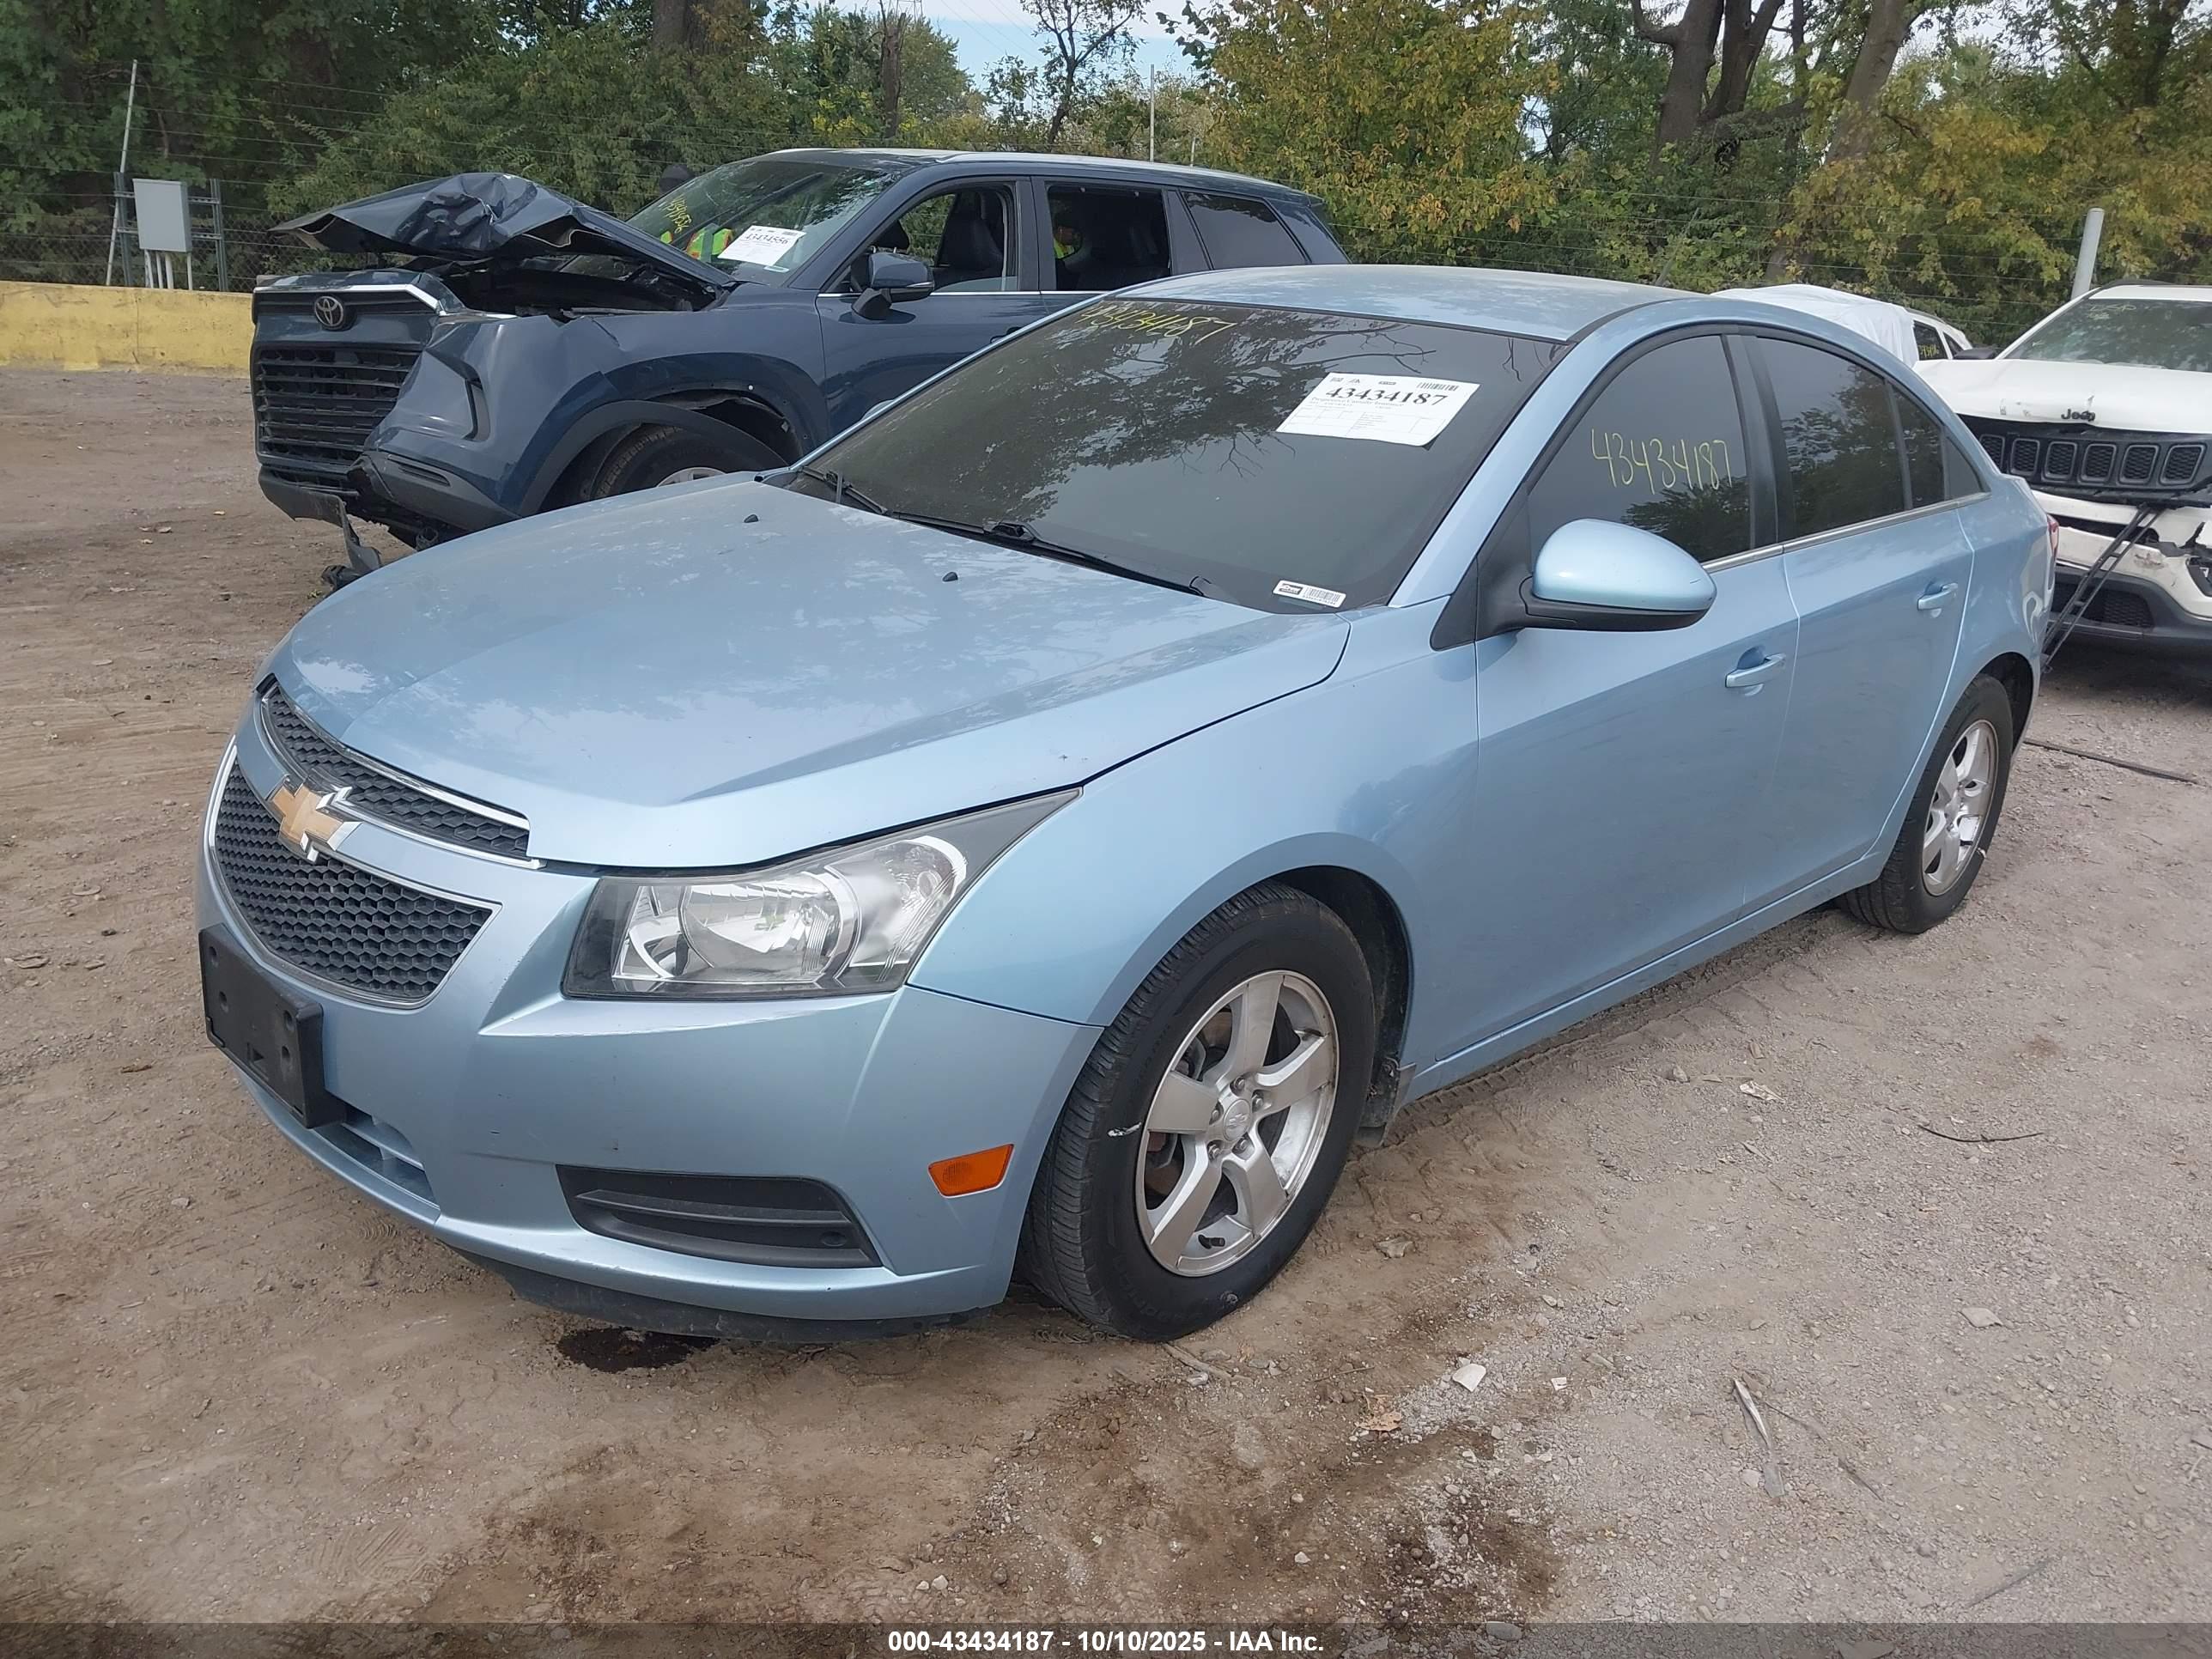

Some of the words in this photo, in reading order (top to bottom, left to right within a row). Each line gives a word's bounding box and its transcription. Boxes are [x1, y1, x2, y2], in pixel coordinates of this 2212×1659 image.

[1325, 386, 1449, 407] 43434187
[2061, 408, 2096, 422] Jeep
[1591, 428, 1733, 495] 43434187
